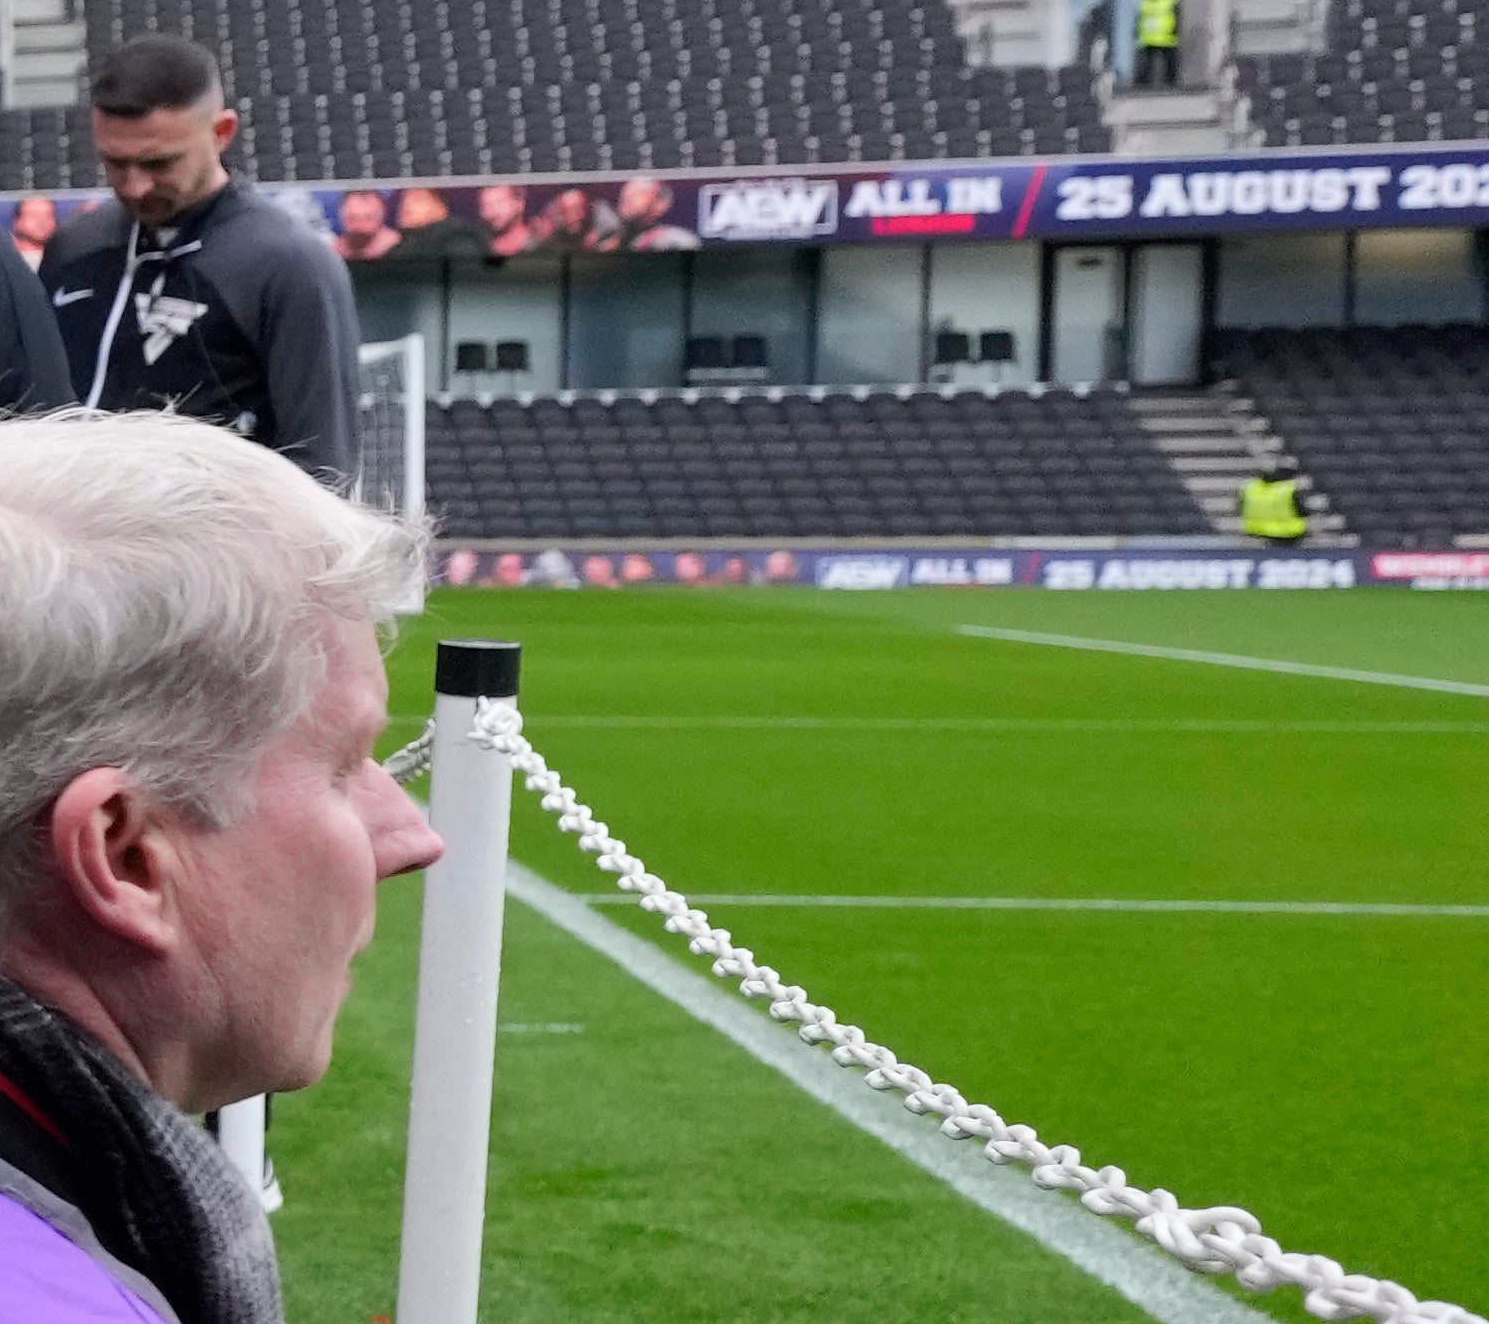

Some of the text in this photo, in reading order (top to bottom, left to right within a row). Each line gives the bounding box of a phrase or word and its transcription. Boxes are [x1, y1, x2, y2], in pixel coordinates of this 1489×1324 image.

[845, 179, 942, 217] ALL
[944, 176, 1003, 214] IN
[1055, 175, 1134, 222] 25
[1138, 165, 1392, 219] AUGUST
